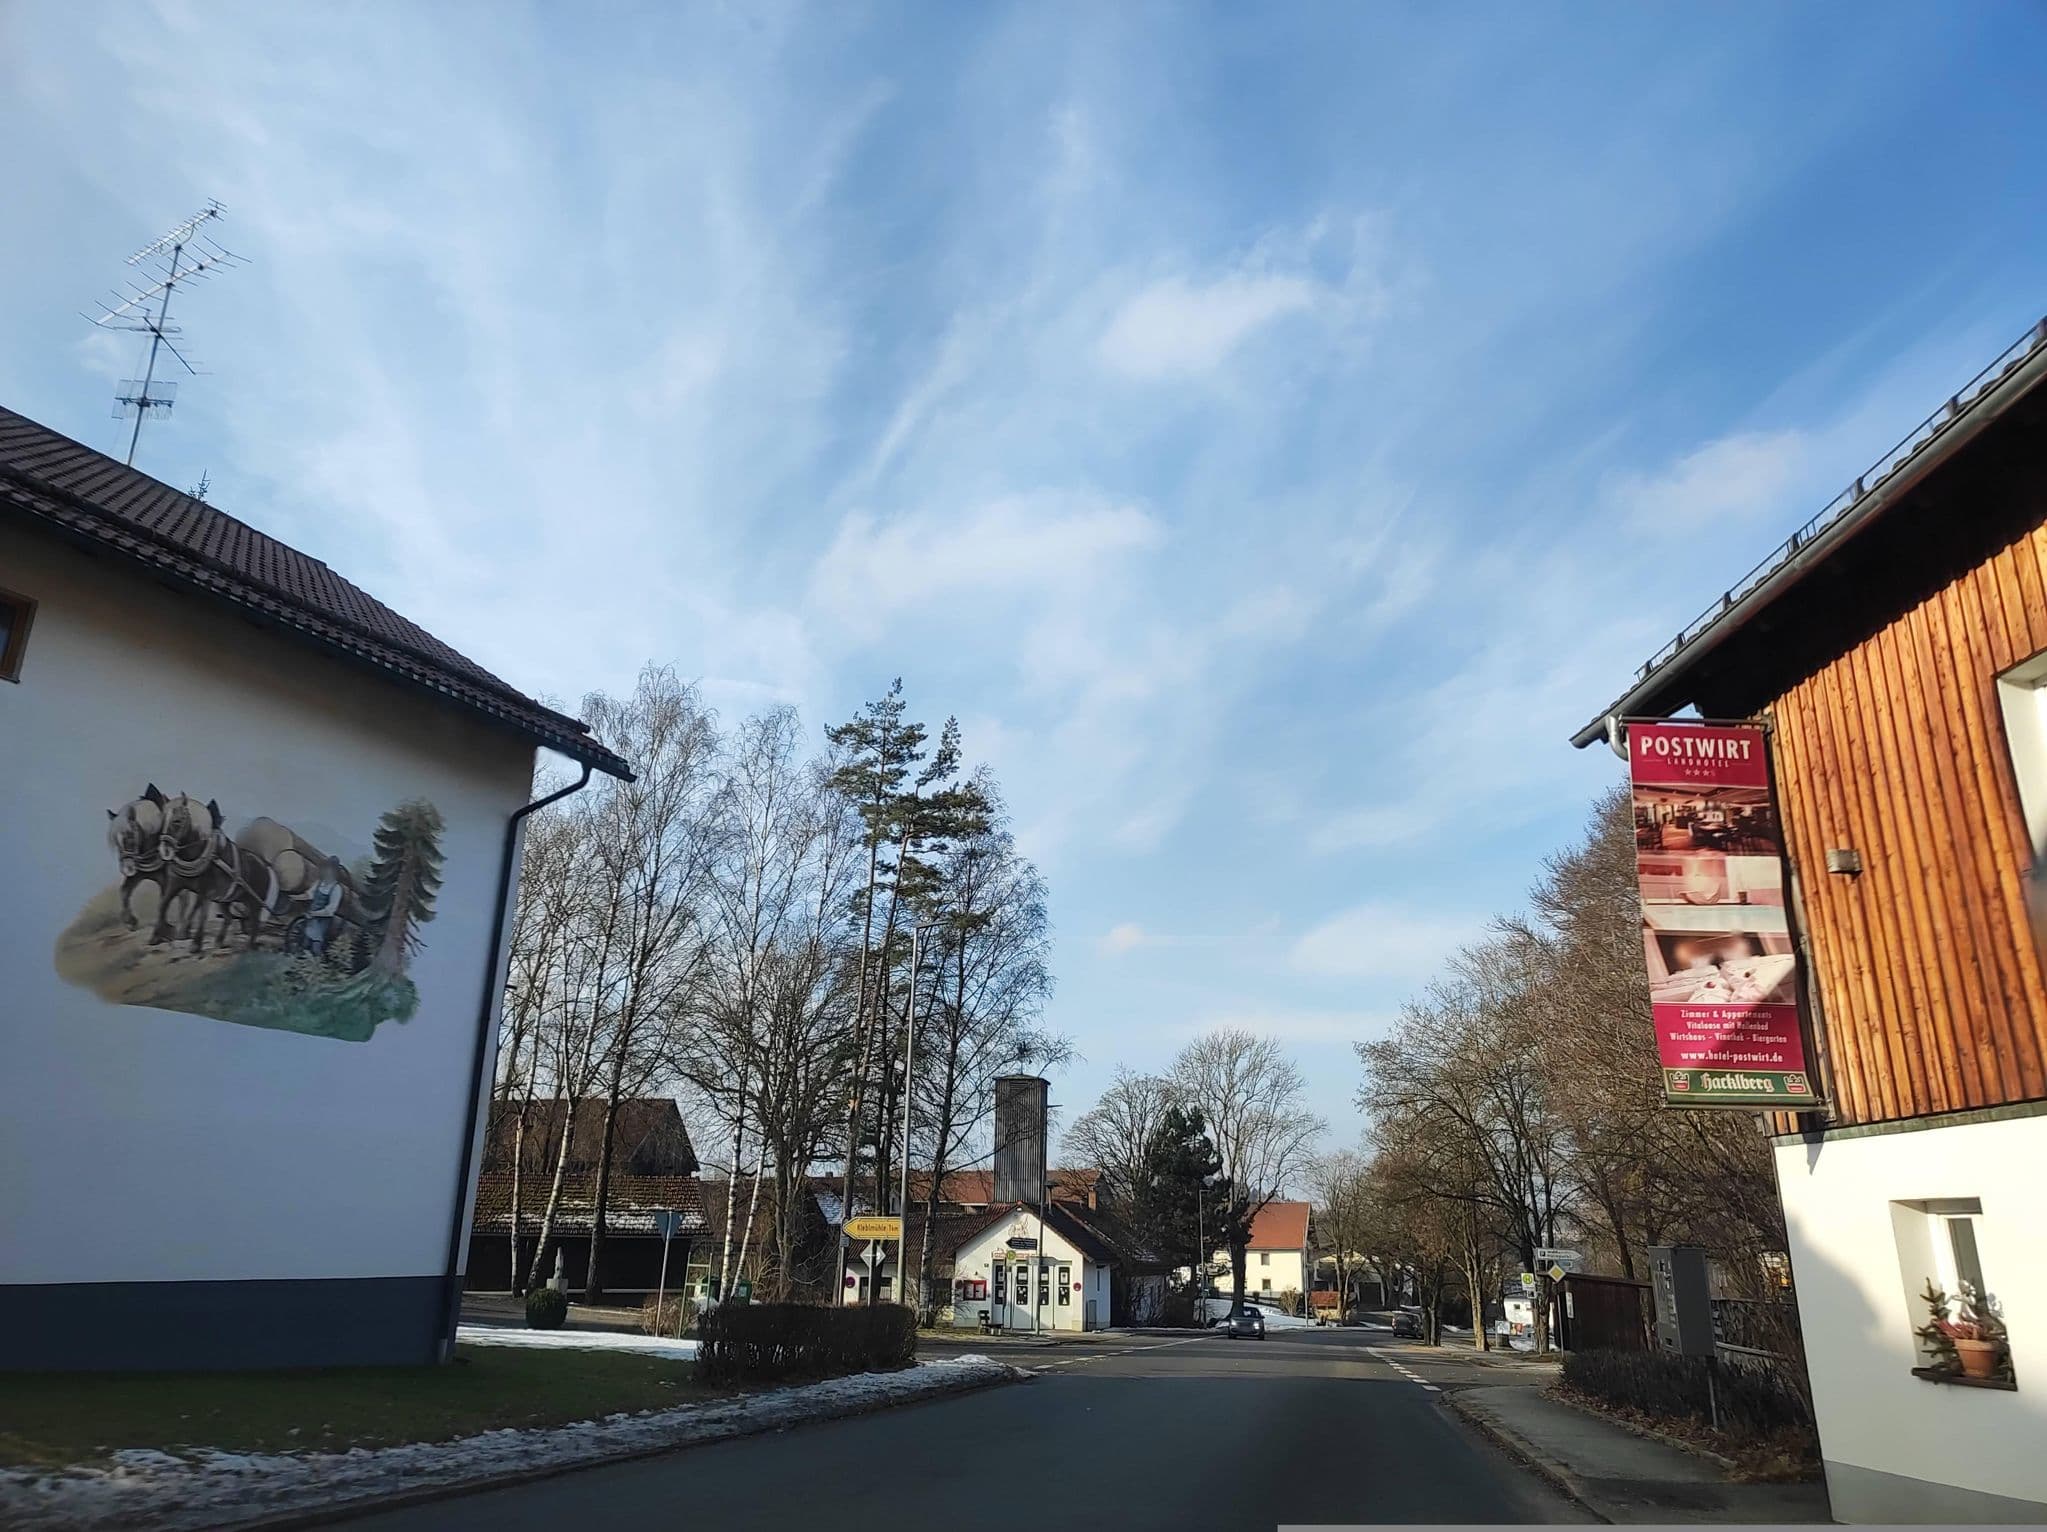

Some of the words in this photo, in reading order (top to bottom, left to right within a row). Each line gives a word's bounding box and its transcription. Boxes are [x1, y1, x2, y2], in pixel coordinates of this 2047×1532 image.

[1641, 736, 1751, 760] POSTWIRT
[1680, 1009, 1709, 1018] Zimmer
[1713, 1010, 1719, 1018] &
[1722, 1021, 1735, 1030] mit
[1669, 1032, 1706, 1041] Wirtshaus
[1680, 1049, 1783, 1063] www.hotel-postwirt.de
[1701, 1072, 1775, 1093] Hacklberg
